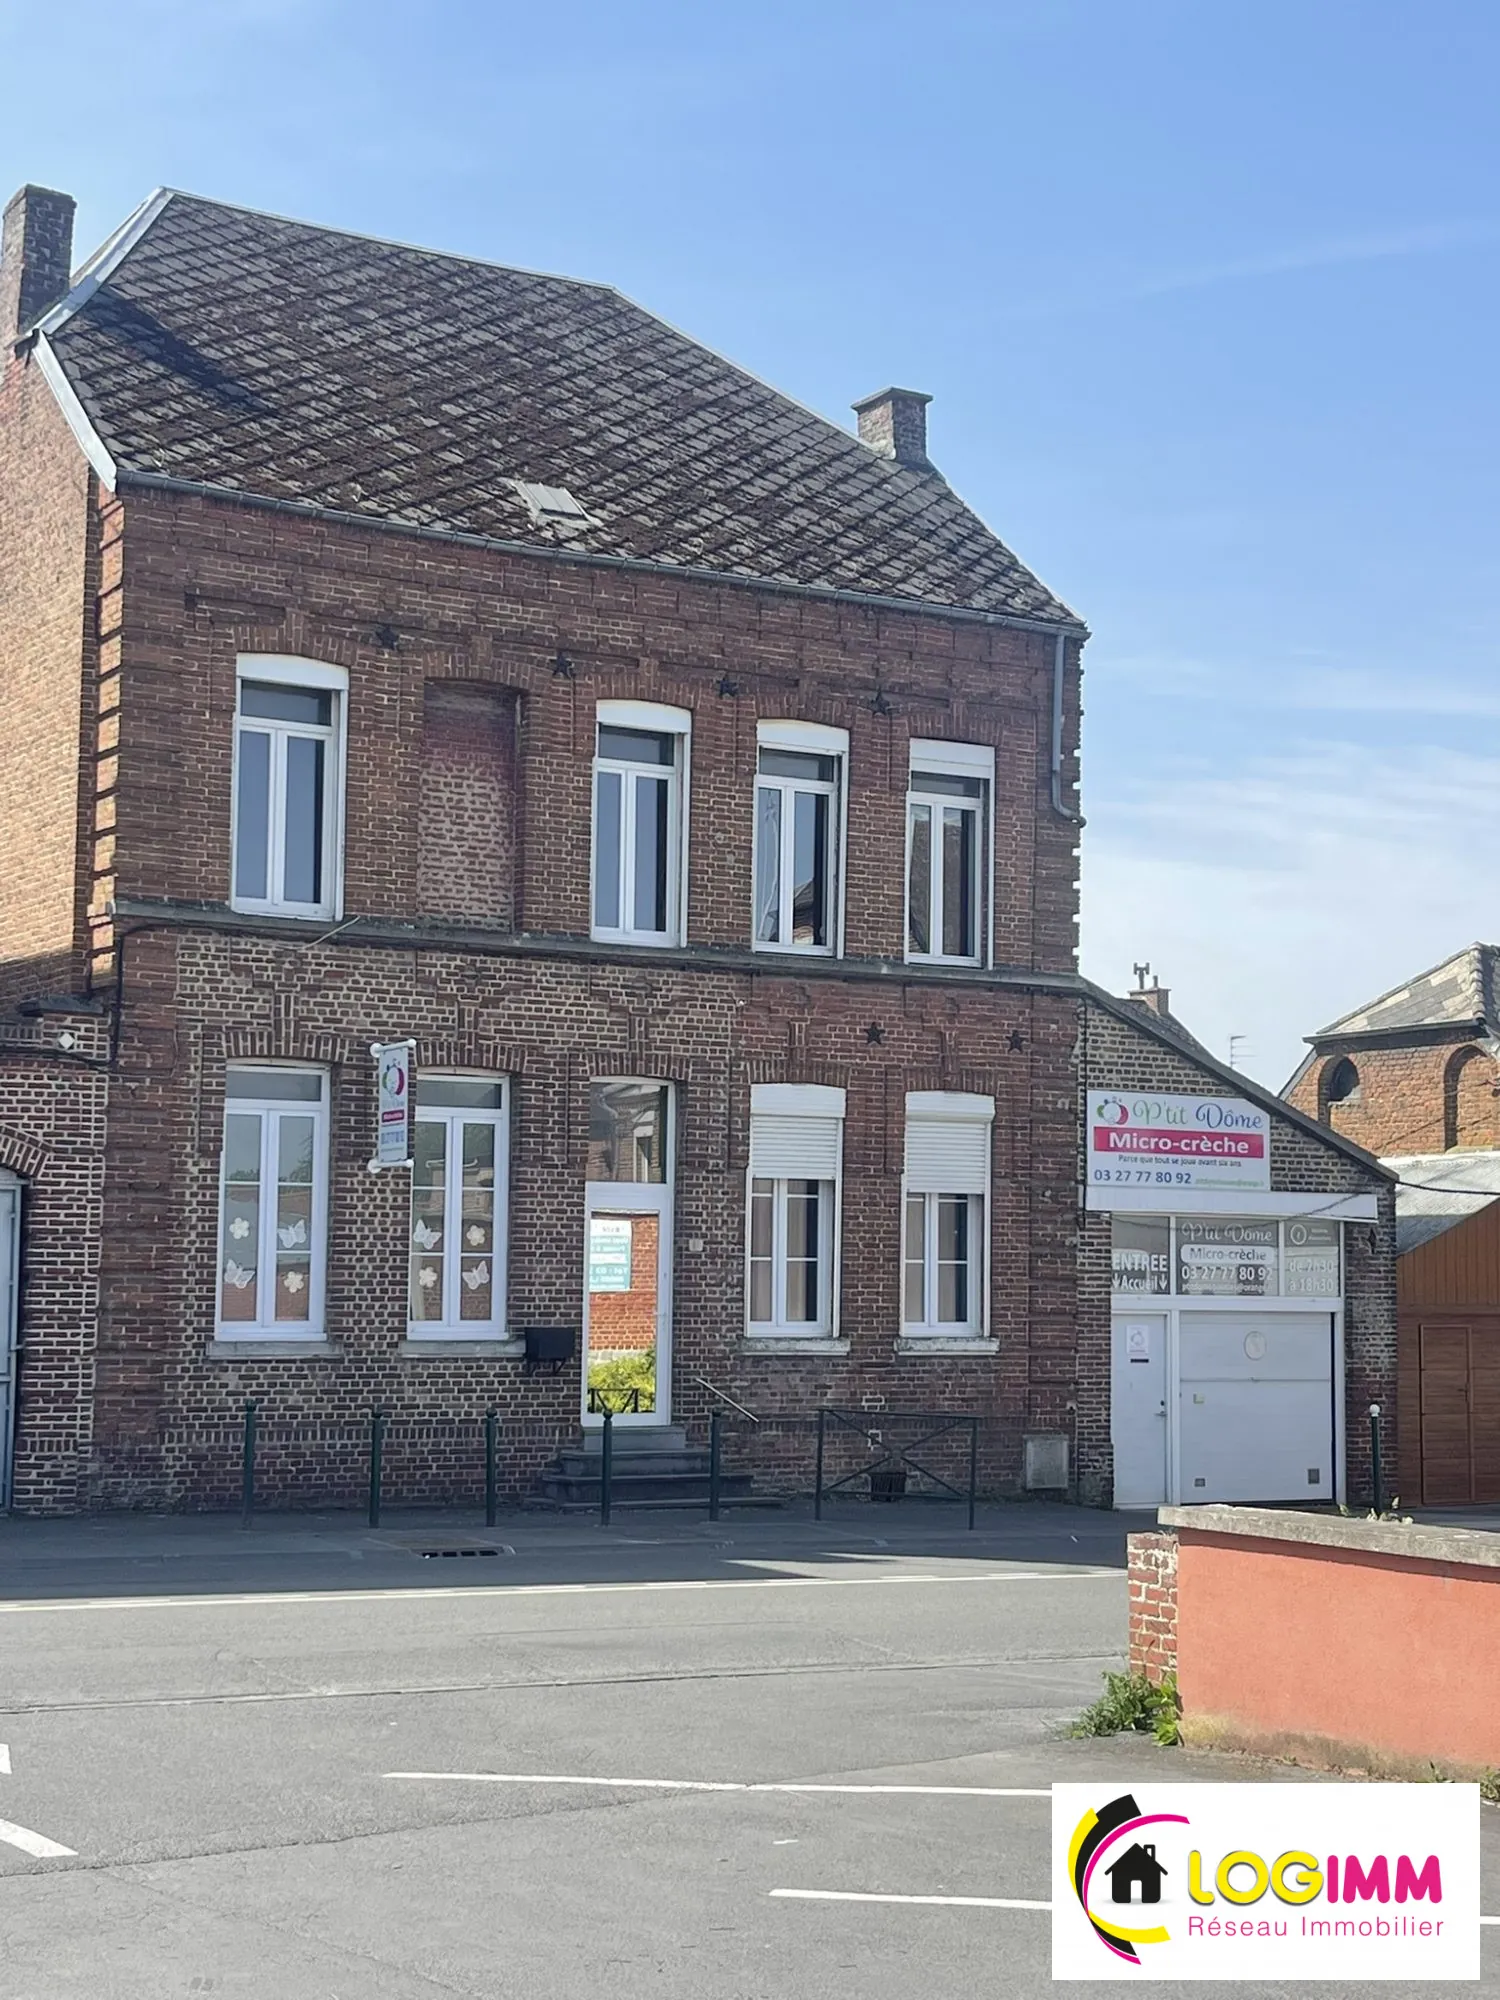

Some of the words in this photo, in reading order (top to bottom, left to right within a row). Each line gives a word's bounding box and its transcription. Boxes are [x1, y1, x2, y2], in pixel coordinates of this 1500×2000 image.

[1132, 1099, 1189, 1126] P'tit
[1195, 1102, 1264, 1129] Dôme
[1109, 1131, 1249, 1154] Micro-crèche
[1118, 1154, 1138, 1163] Parce
[1140, 1156, 1153, 1165] que
[1154, 1156, 1170, 1164] tout
[1198, 1158, 1217, 1166] avant
[1094, 1169, 1111, 1181] 03
[1115, 1170, 1131, 1182] 27
[1135, 1170, 1151, 1183] 77
[1155, 1171, 1172, 1184] 80
[1175, 1172, 1192, 1184] 92
[1181, 1265, 1197, 1280] 03
[1201, 1265, 1217, 1280] 27
[1220, 1266, 1236, 1280] 77
[1239, 1266, 1255, 1280] 80
[1258, 1266, 1273, 1281] 92
[1289, 1259, 1303, 1273] de
[1121, 1274, 1158, 1291] Accueil
[1299, 1277, 1334, 1293] 18h30
